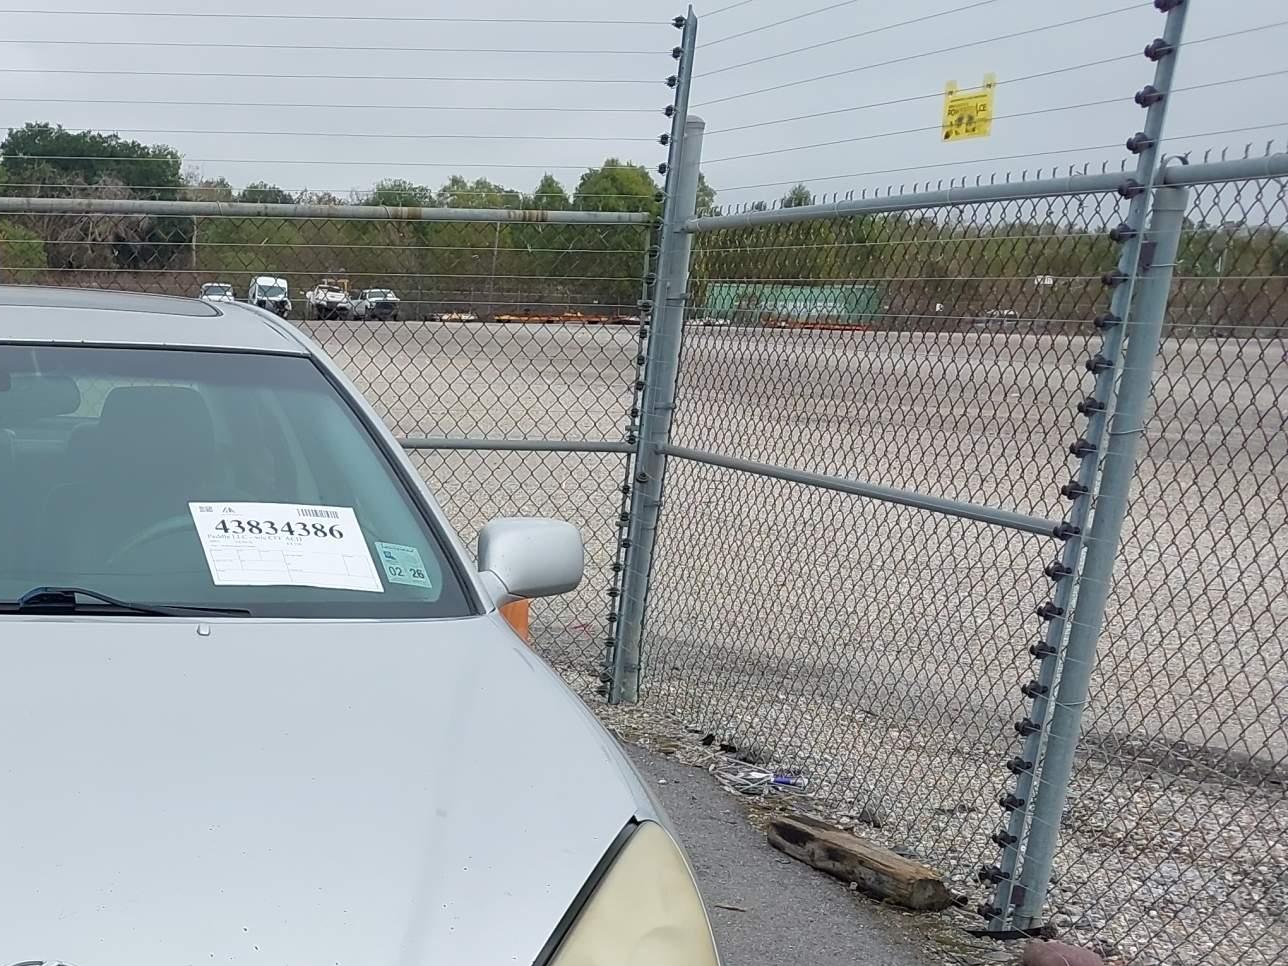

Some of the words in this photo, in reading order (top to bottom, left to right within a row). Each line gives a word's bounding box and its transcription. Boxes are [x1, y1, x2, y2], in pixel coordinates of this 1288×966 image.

[215, 519, 343, 539] 43834386
[389, 566, 405, 576] 02
[409, 568, 425, 578] 26
